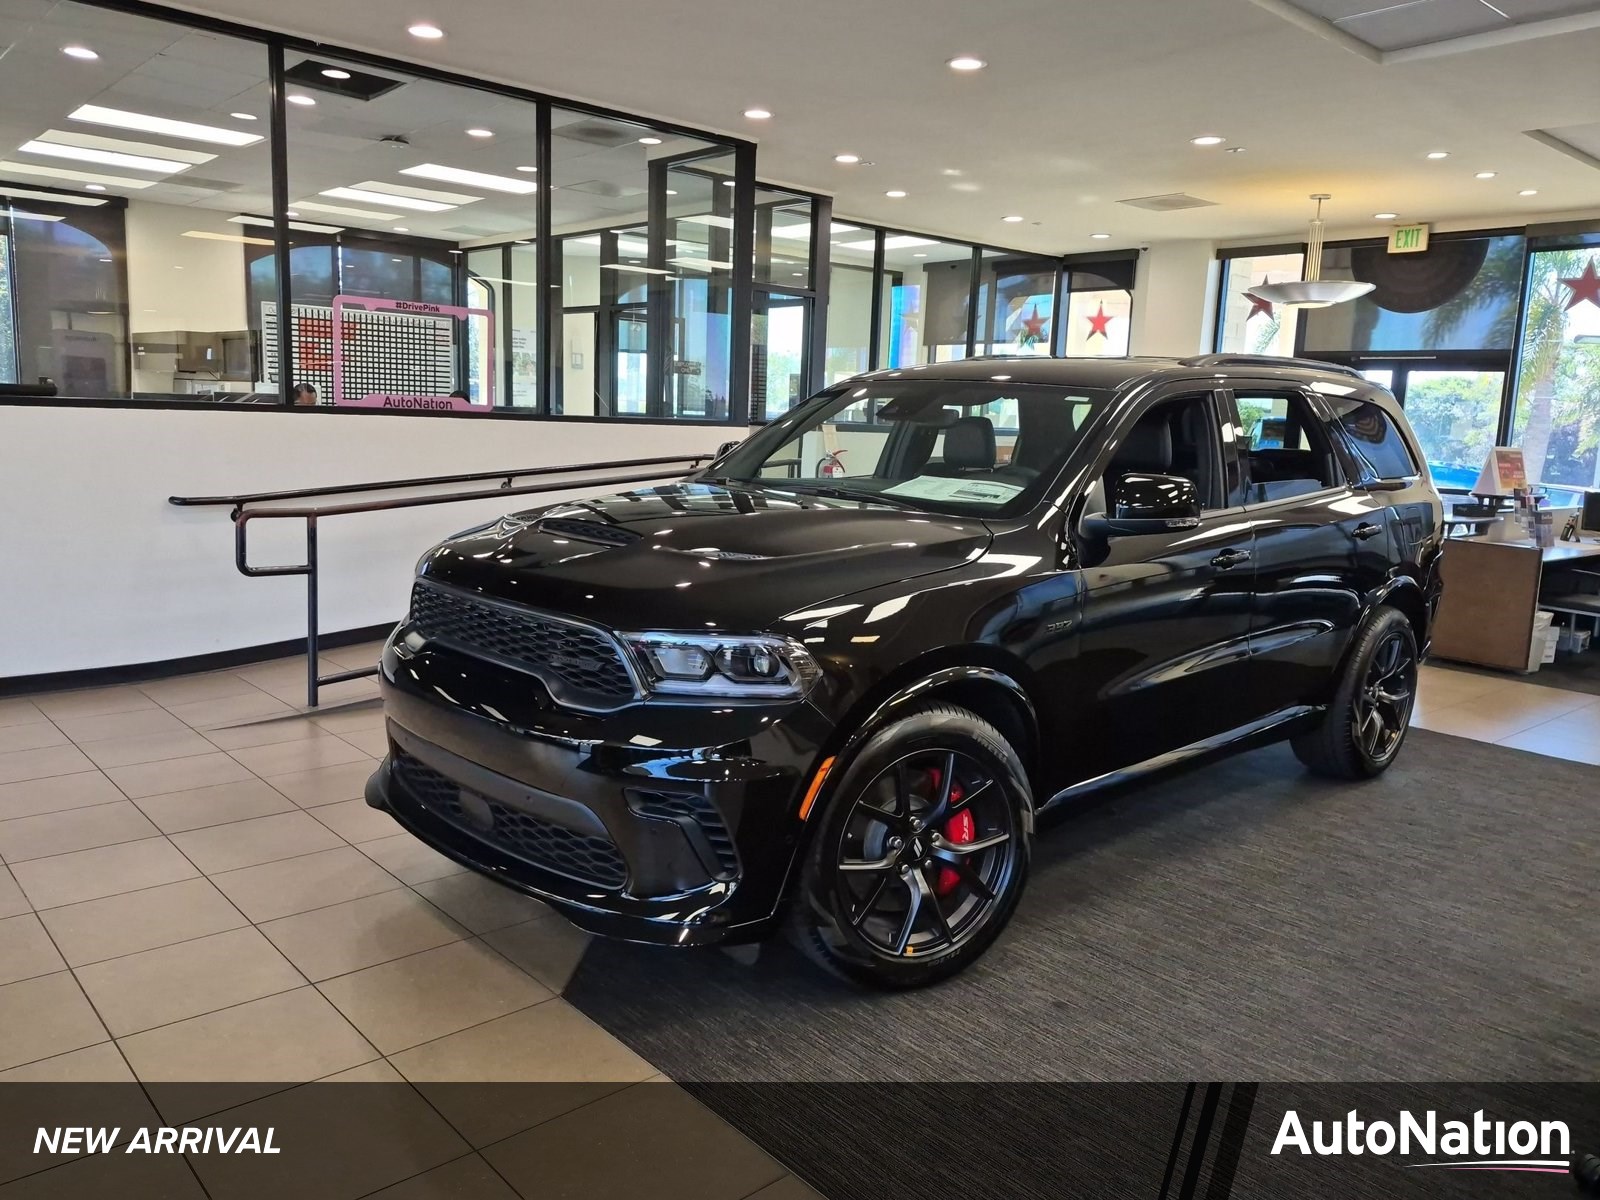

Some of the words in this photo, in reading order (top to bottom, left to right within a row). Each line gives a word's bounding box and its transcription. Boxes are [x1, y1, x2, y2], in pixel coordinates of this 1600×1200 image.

[1395, 229, 1422, 248] EXIT
[395, 302, 440, 312] #DrivePink
[383, 396, 453, 410] AutoNation
[961, 813, 969, 842] SR
